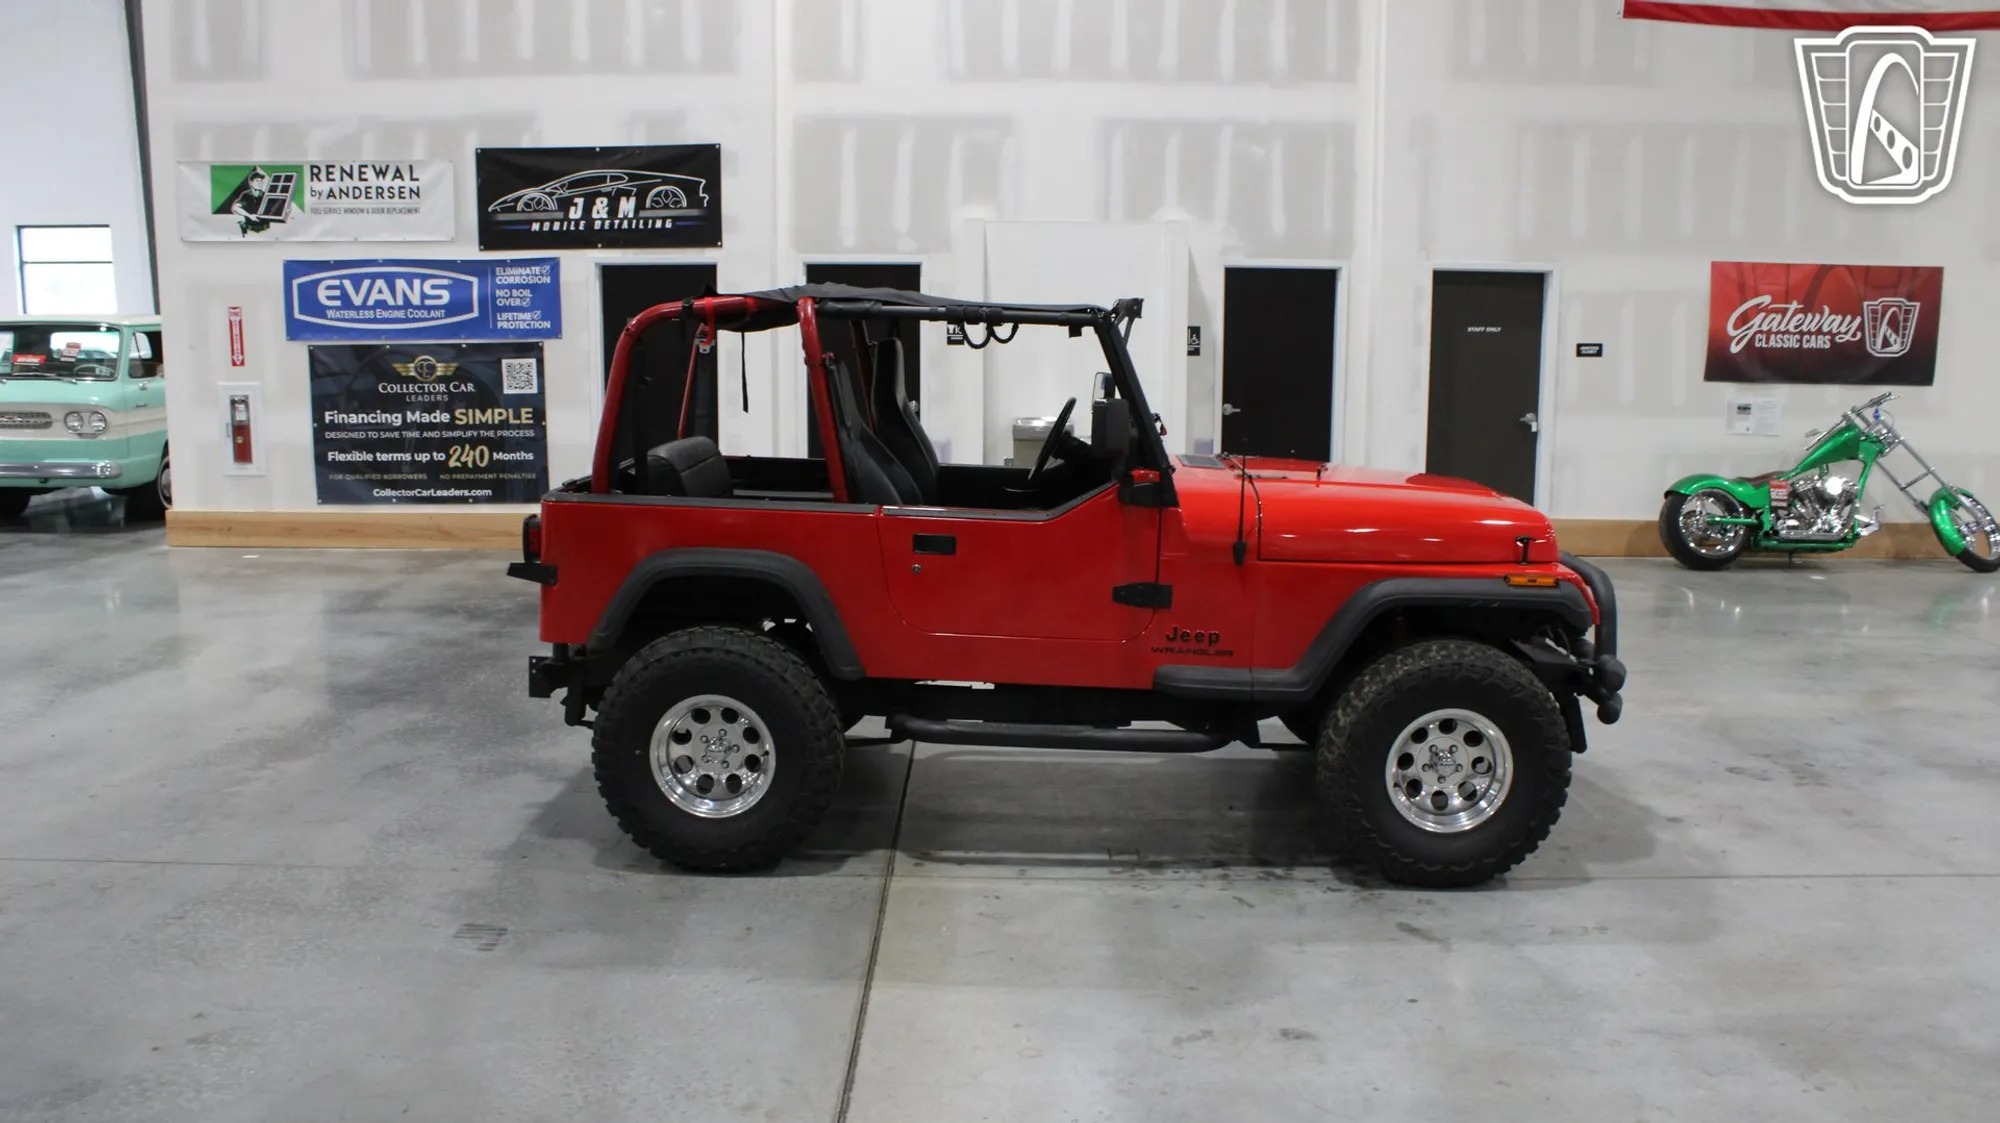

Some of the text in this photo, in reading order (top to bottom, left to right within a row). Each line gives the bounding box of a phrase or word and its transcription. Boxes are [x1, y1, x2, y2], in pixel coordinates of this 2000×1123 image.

[310, 164, 420, 182] RENEWAL
[310, 186, 421, 199] by ANDERSEN
[568, 196, 636, 219] J & M
[531, 219, 673, 232] MOBILE DETAILING
[496, 267, 541, 275] ELIMINATE
[496, 276, 551, 284] CORROSION
[317, 278, 451, 307] EVANS
[496, 289, 533, 297] NO BOIL
[496, 298, 521, 306] OVER
[497, 312, 532, 320] LIFETIME
[497, 321, 551, 329] PROTECTION
[1726, 294, 1862, 353] Gateway
[1755, 333, 1831, 349] CLASSIC CARS
[406, 394, 449, 402] LEADERS
[324, 407, 534, 426] Financing Made SIMPLE
[325, 431, 366, 439] DESIGNED
[367, 431, 379, 439] TO
[379, 431, 401, 439] SAVE
[441, 430, 478, 438] SIMPLIFY
[497, 429, 535, 437] PROCESS
[327, 443, 535, 468] Flexible terms up to 240 Months
[372, 488, 493, 498] CollectorCarLeaders.com
[1166, 626, 1220, 646] Jeep
